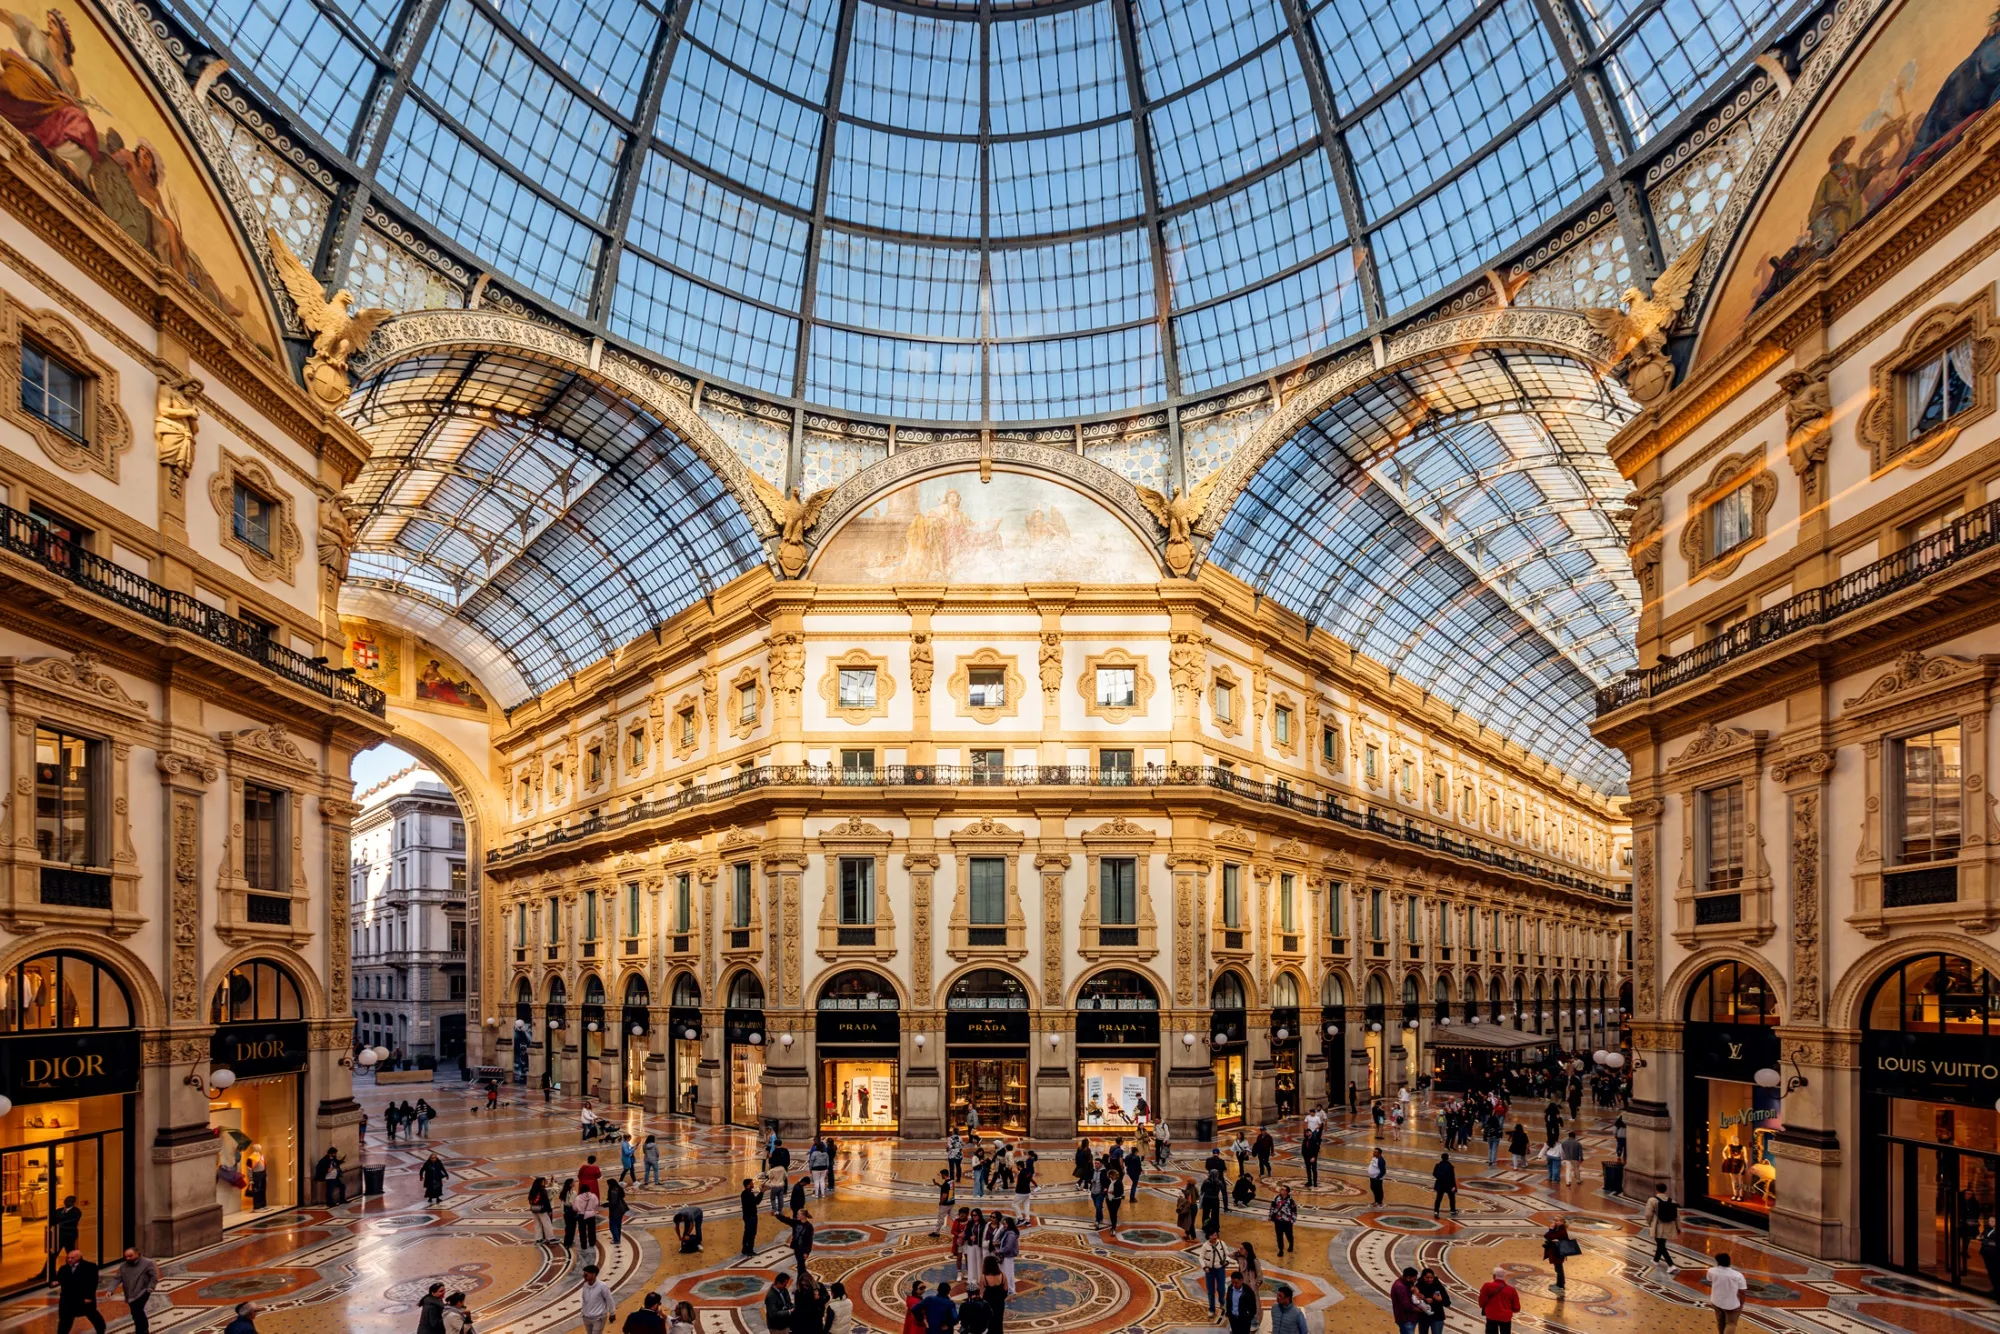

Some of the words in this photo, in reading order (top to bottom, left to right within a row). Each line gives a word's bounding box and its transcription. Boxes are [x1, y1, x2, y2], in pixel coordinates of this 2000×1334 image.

[839, 1023, 877, 1031] PRADA
[968, 1023, 1007, 1031] PRADA
[1098, 1023, 1137, 1031] PRADA
[236, 1040, 286, 1062] DIOR
[1727, 1042, 1743, 1060] LV
[27, 1054, 106, 1082] DIOR
[1877, 1056, 1926, 1074] LOUIS
[1930, 1060, 1999, 1080] VUITTO
